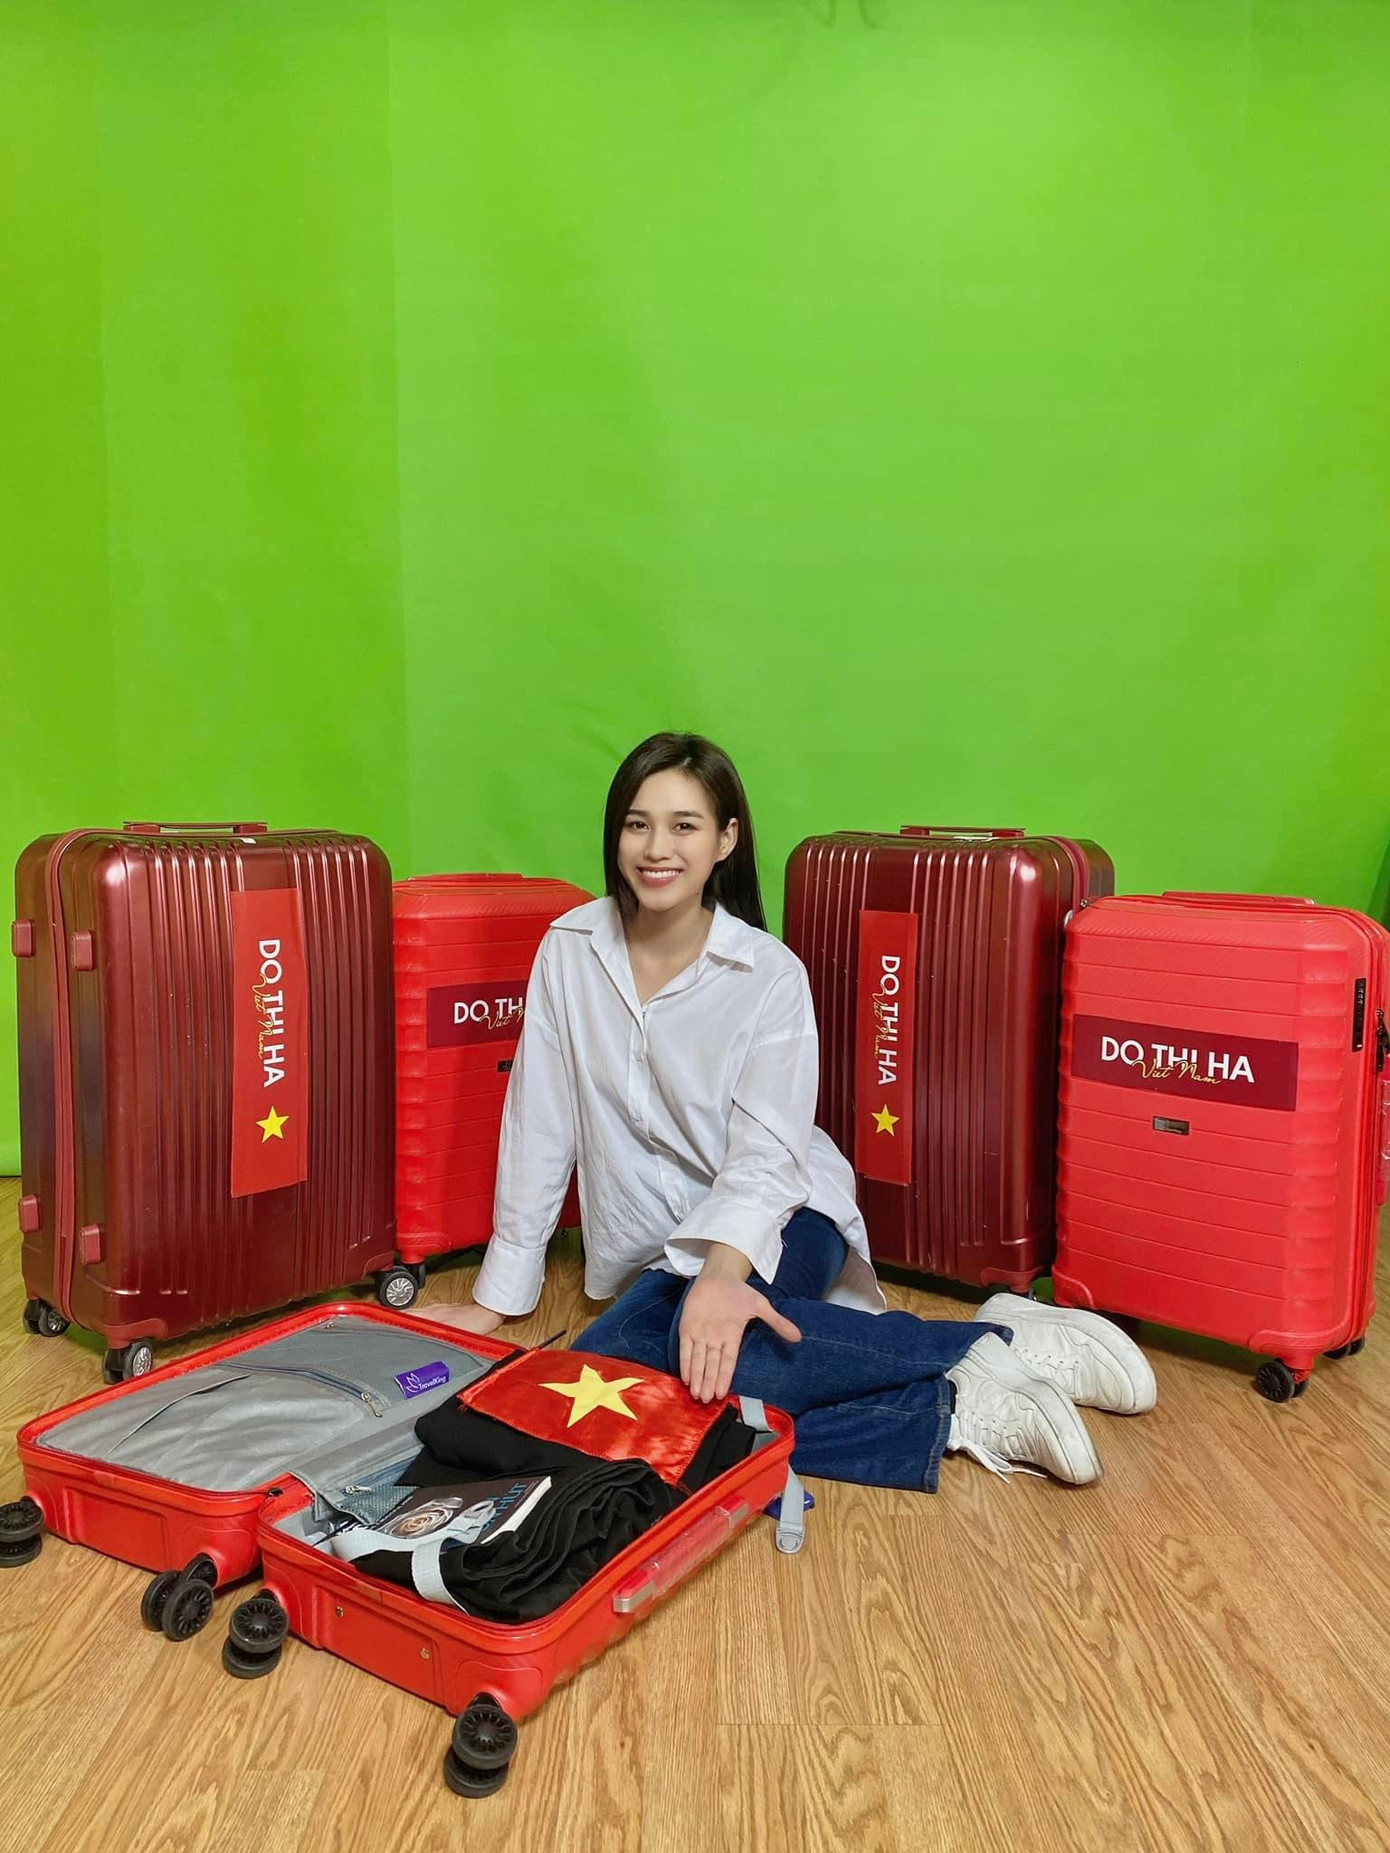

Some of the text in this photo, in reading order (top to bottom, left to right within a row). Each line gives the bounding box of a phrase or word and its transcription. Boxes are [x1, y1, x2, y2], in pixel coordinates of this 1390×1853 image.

[258, 939, 285, 1088] DO THI HA
[453, 999, 490, 1024] DO
[494, 997, 524, 1019] TH
[878, 955, 901, 1086] DO THI HA
[257, 1014, 275, 1060] Nam
[1101, 1036, 1255, 1084] DO THI HA
[1174, 1060, 1222, 1085] Nam
[418, 1376, 447, 1391] TravelKing
